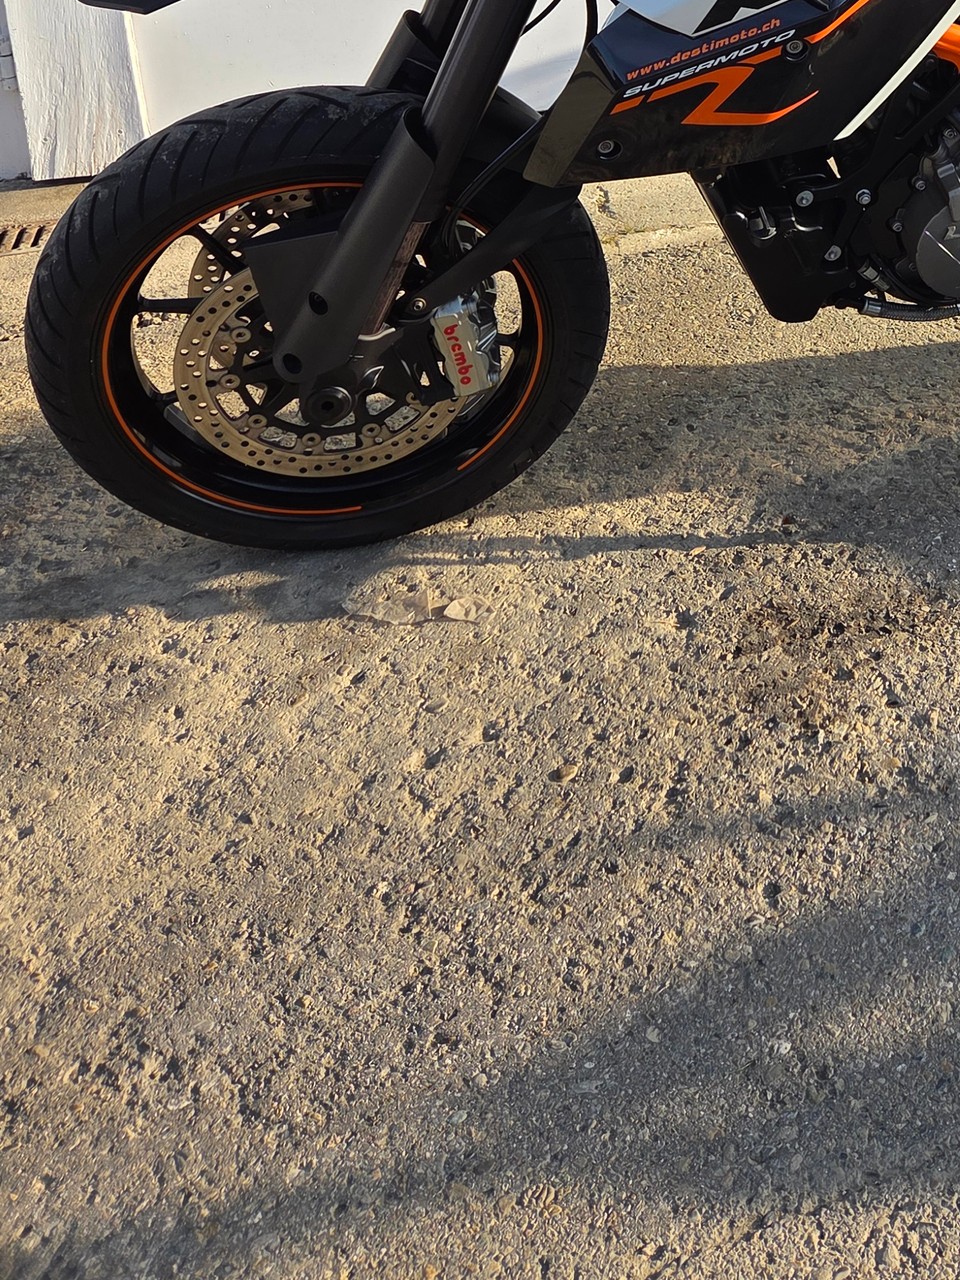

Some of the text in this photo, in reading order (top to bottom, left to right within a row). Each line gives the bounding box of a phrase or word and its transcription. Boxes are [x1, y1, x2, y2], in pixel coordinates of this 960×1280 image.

[623, 29, 796, 98] SUPERMOTO
[626, 18, 781, 81] www.destimoto.ch
[444, 324, 473, 385] brembo
